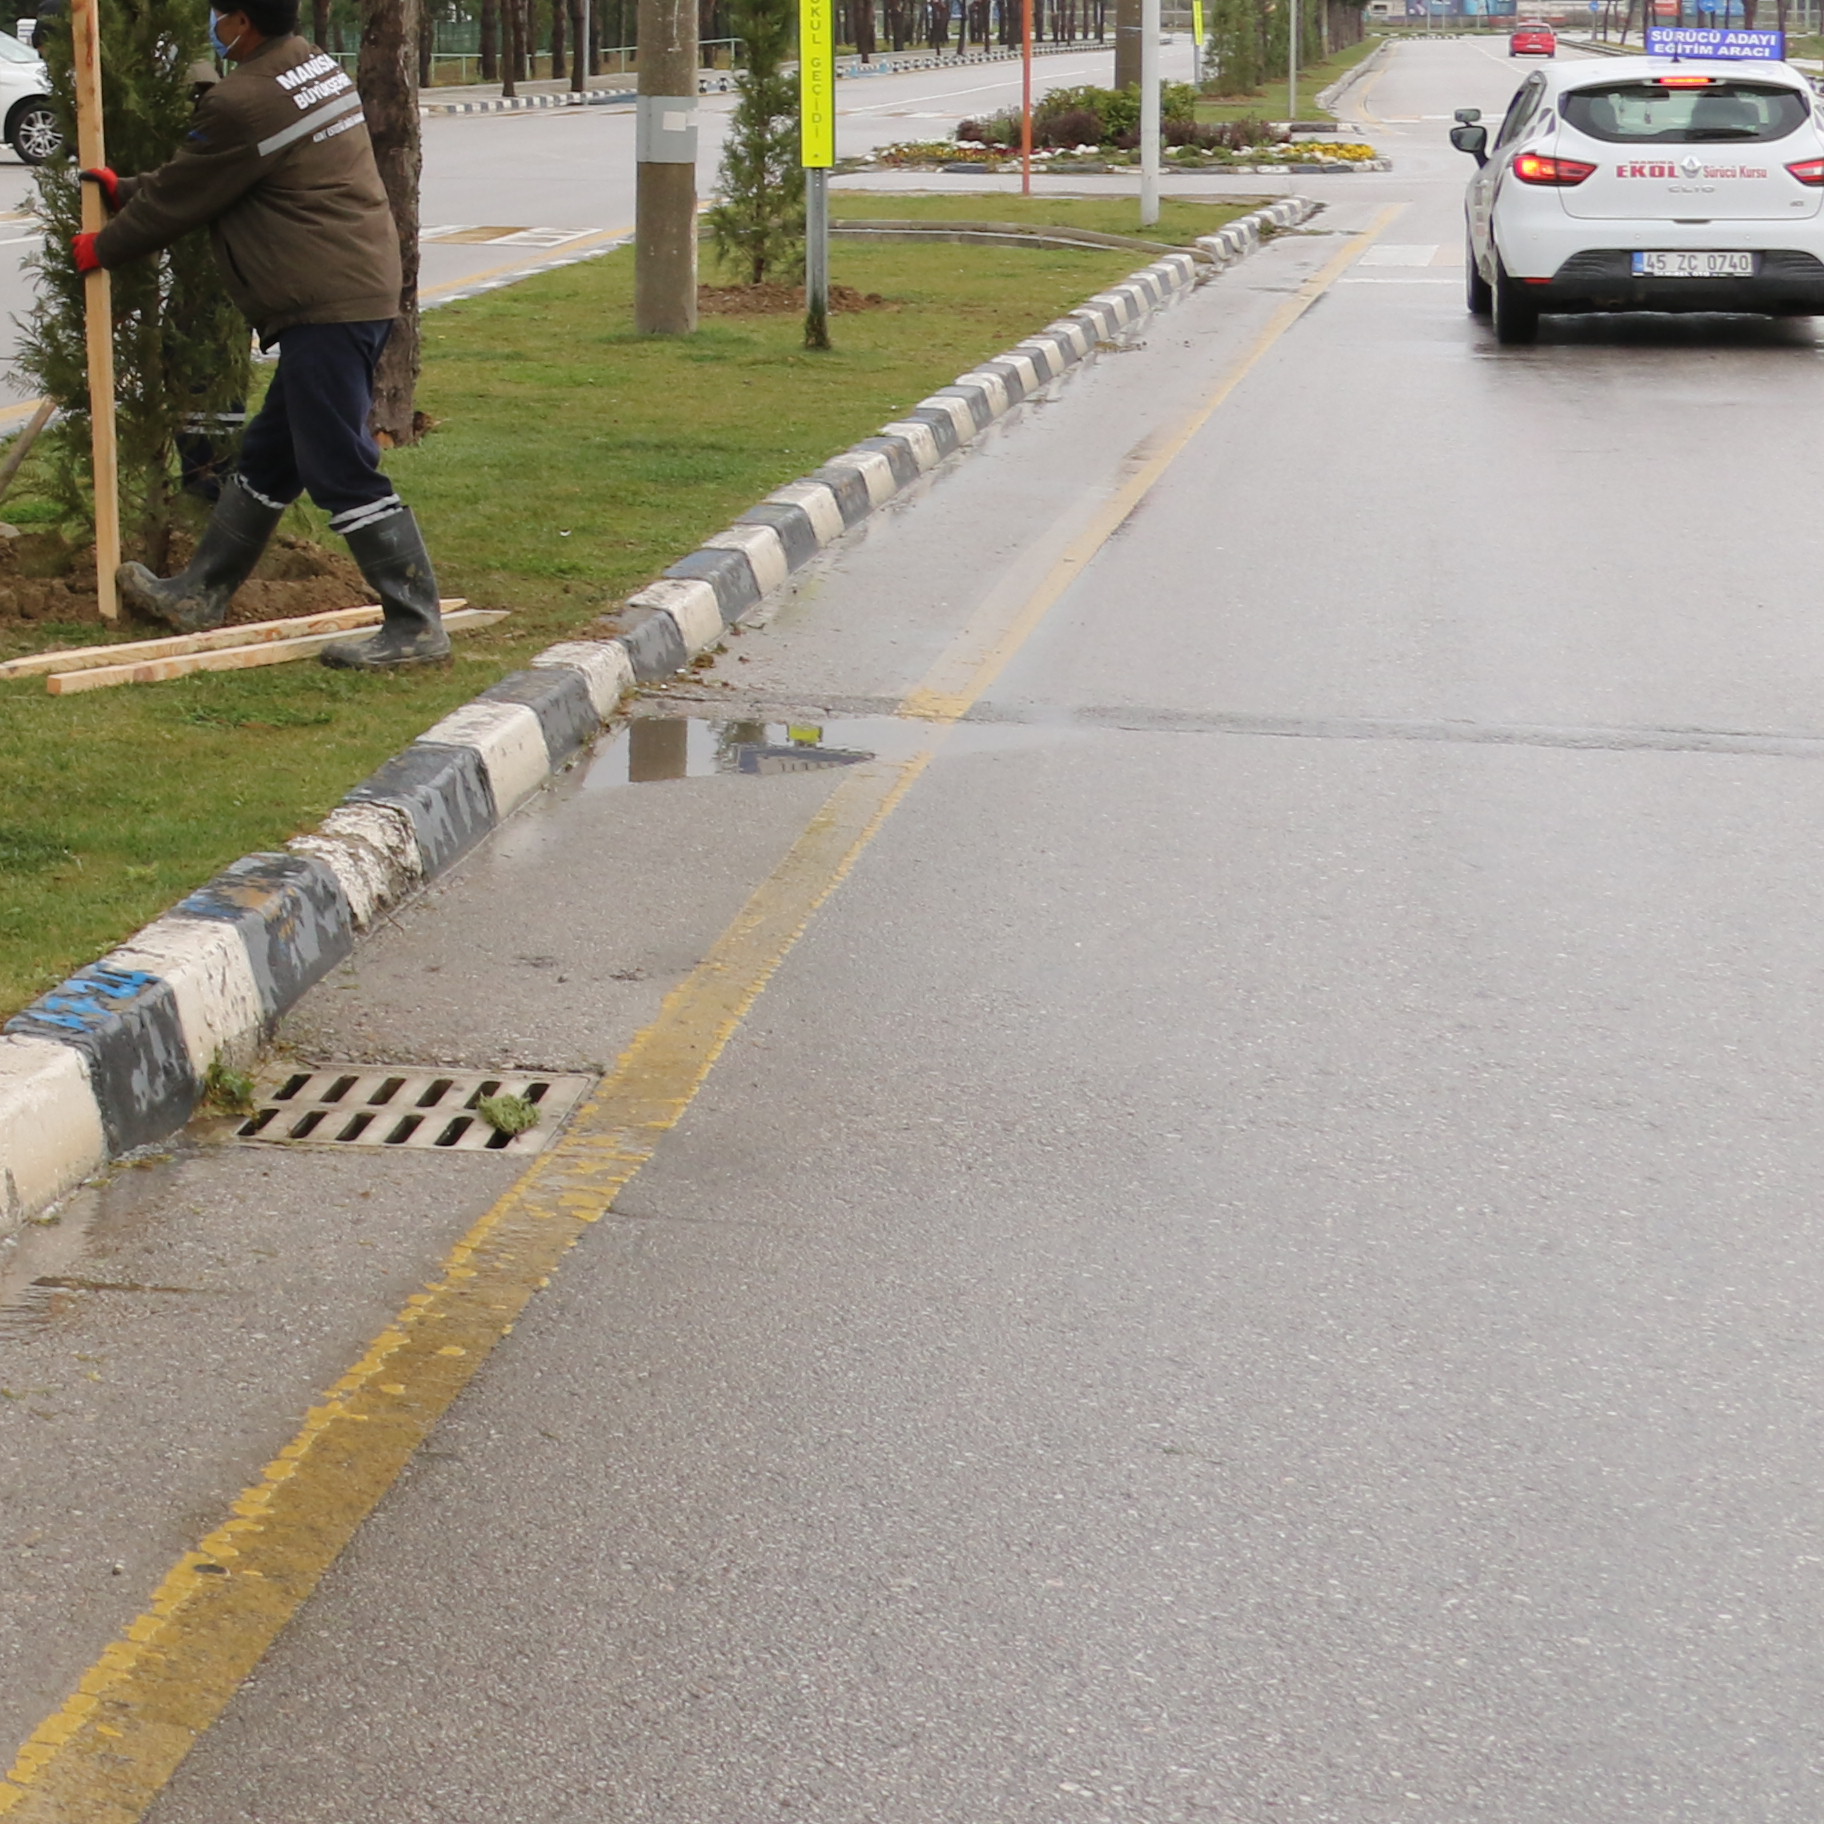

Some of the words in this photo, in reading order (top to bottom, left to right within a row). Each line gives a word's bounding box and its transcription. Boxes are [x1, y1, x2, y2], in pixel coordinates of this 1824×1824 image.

[1652, 29, 1721, 44] SÜRÜCÜ
[1725, 32, 1777, 46] ADAYI
[1653, 42, 1713, 55] EĞİTİM
[1717, 46, 1770, 57] ARACI
[275, 53, 339, 91] MANİSA
[1616, 164, 1680, 178] EKOL
[1739, 165, 1768, 178] Kursu
[1646, 254, 1666, 271] 45
[1677, 254, 1697, 271] ZC
[1707, 254, 1749, 271] 0740
